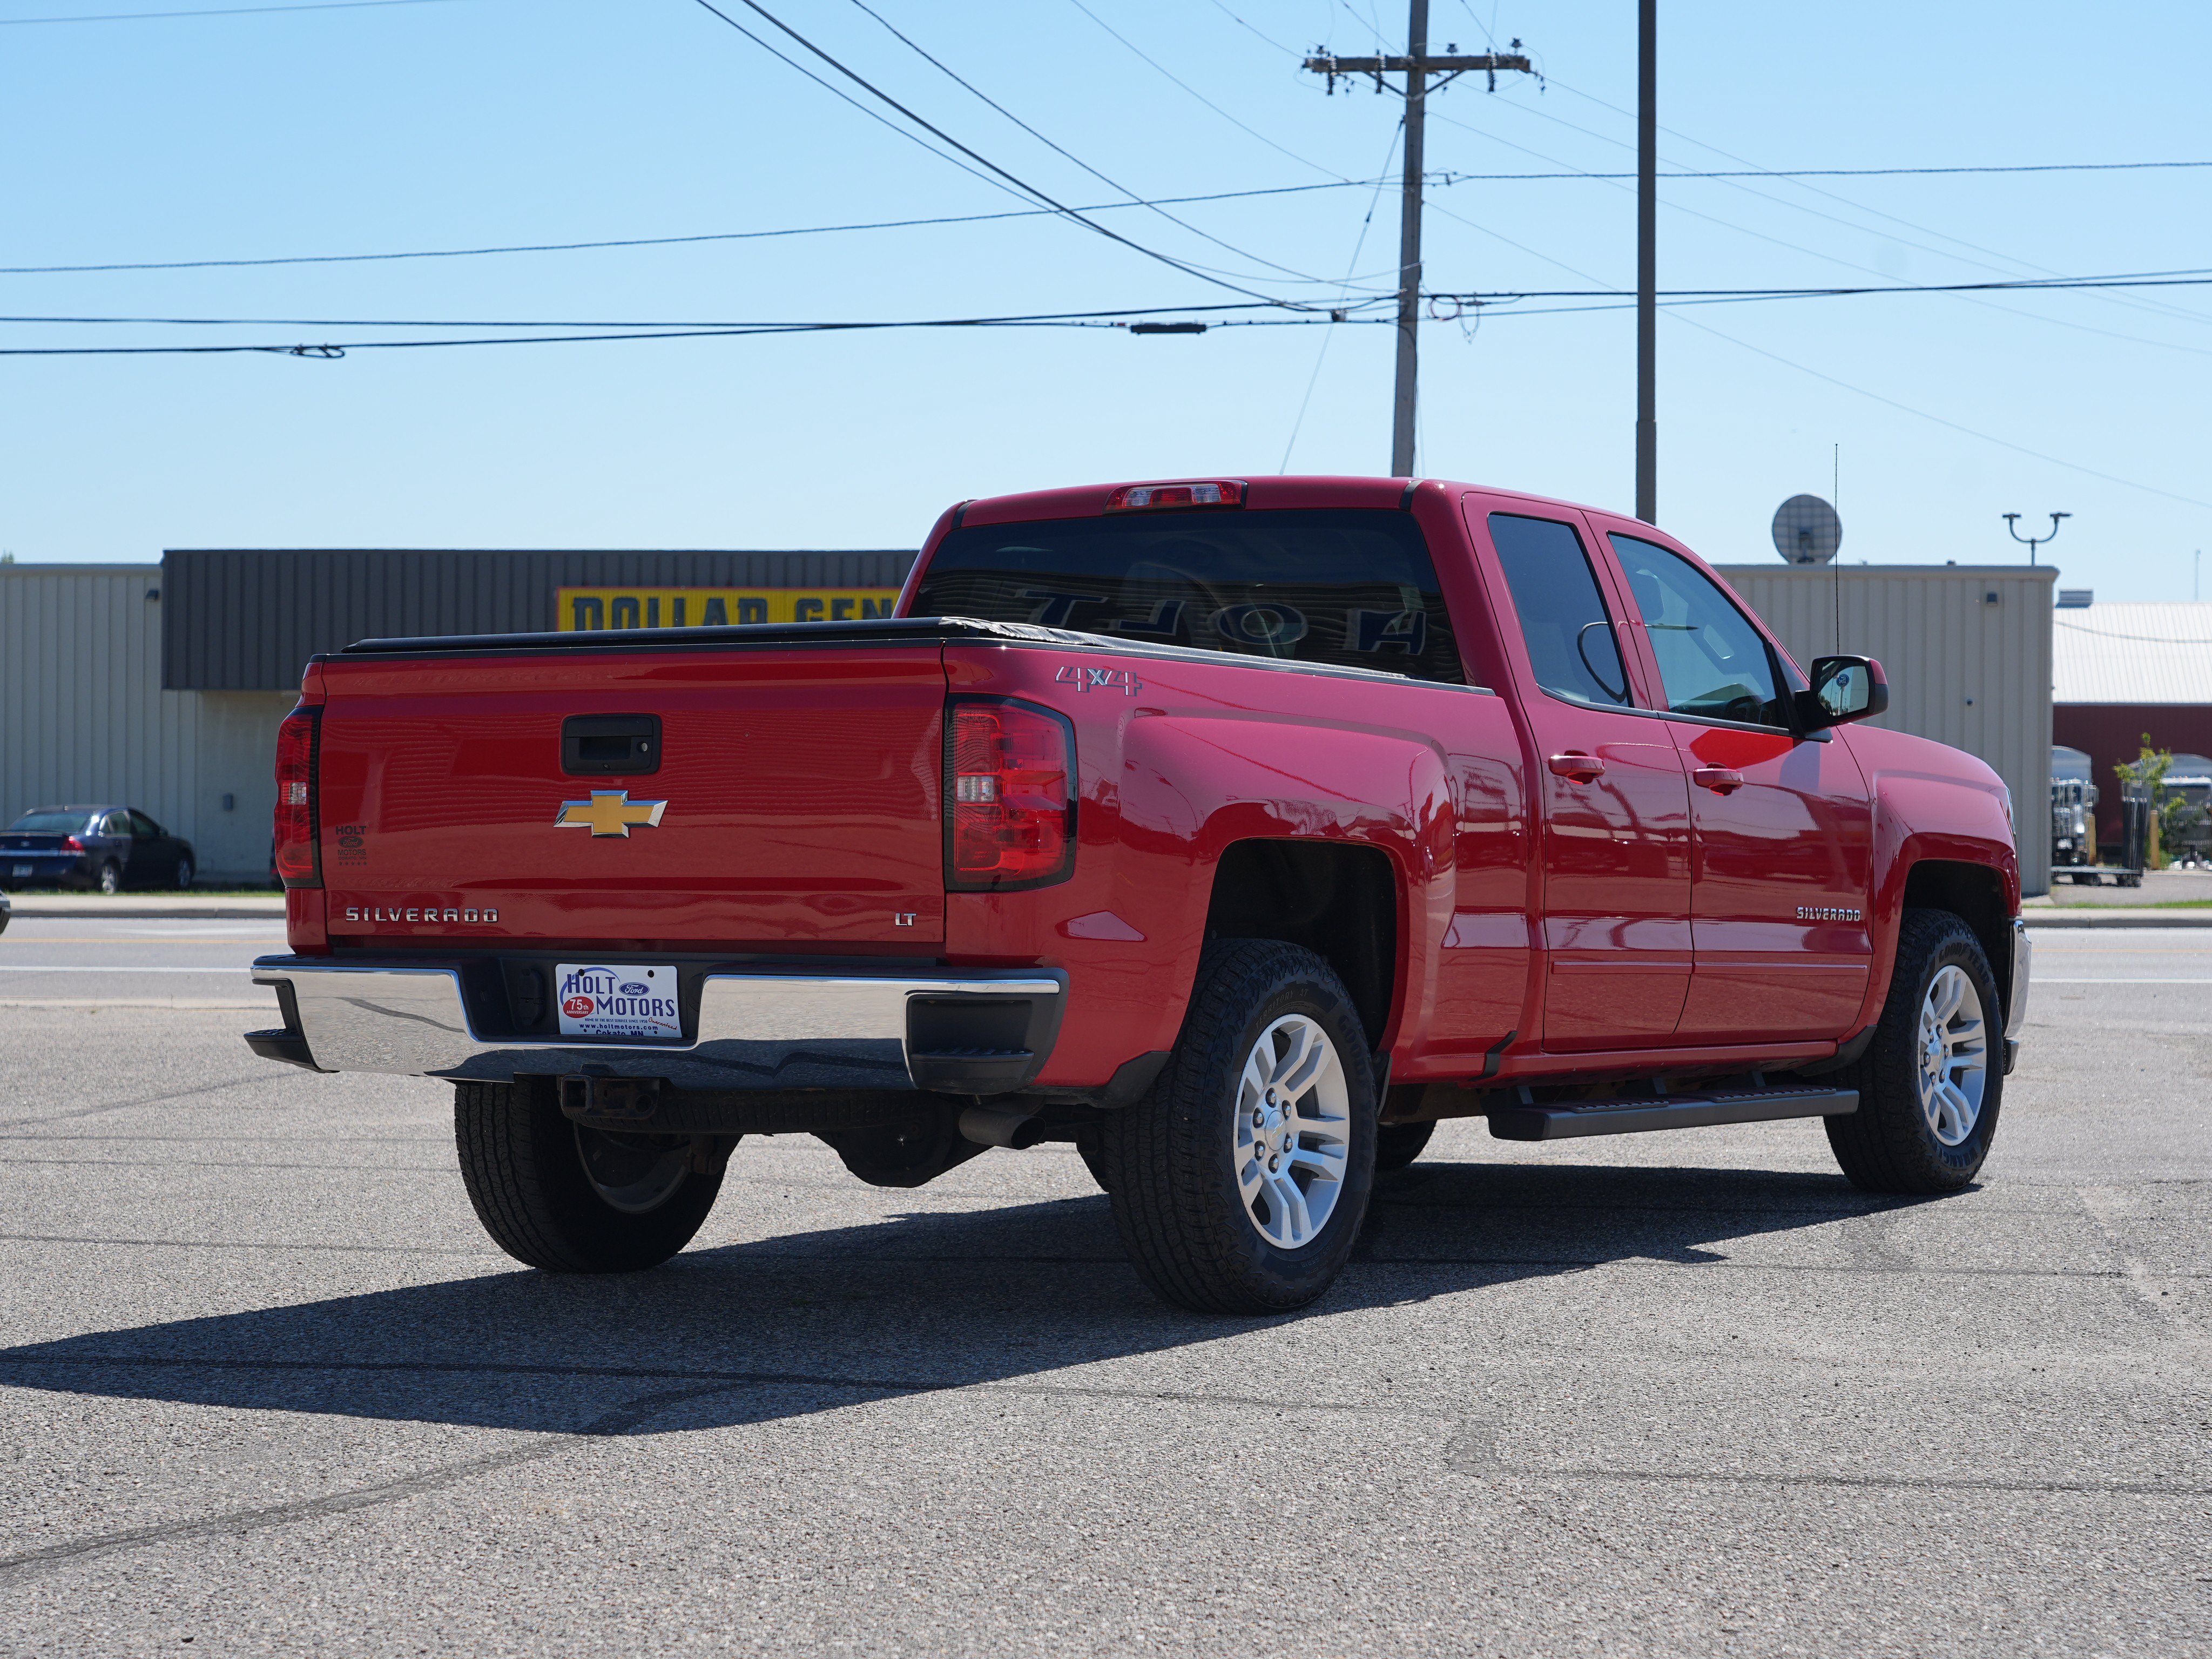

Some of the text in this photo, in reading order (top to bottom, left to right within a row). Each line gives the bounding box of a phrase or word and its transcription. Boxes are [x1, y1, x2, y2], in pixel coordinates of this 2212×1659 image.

[336, 826, 366, 834] HOLT
[346, 907, 498, 922] SILVERADO
[895, 913, 917, 926] LT
[1796, 907, 1861, 921] SILVERADO
[567, 974, 616, 994] HOLT
[570, 999, 589, 1010] 75th
[596, 996, 675, 1017] MOTORS
[1254, 989, 1294, 1029] TERRITORY
[648, 1017, 678, 1030] Guaranteed
